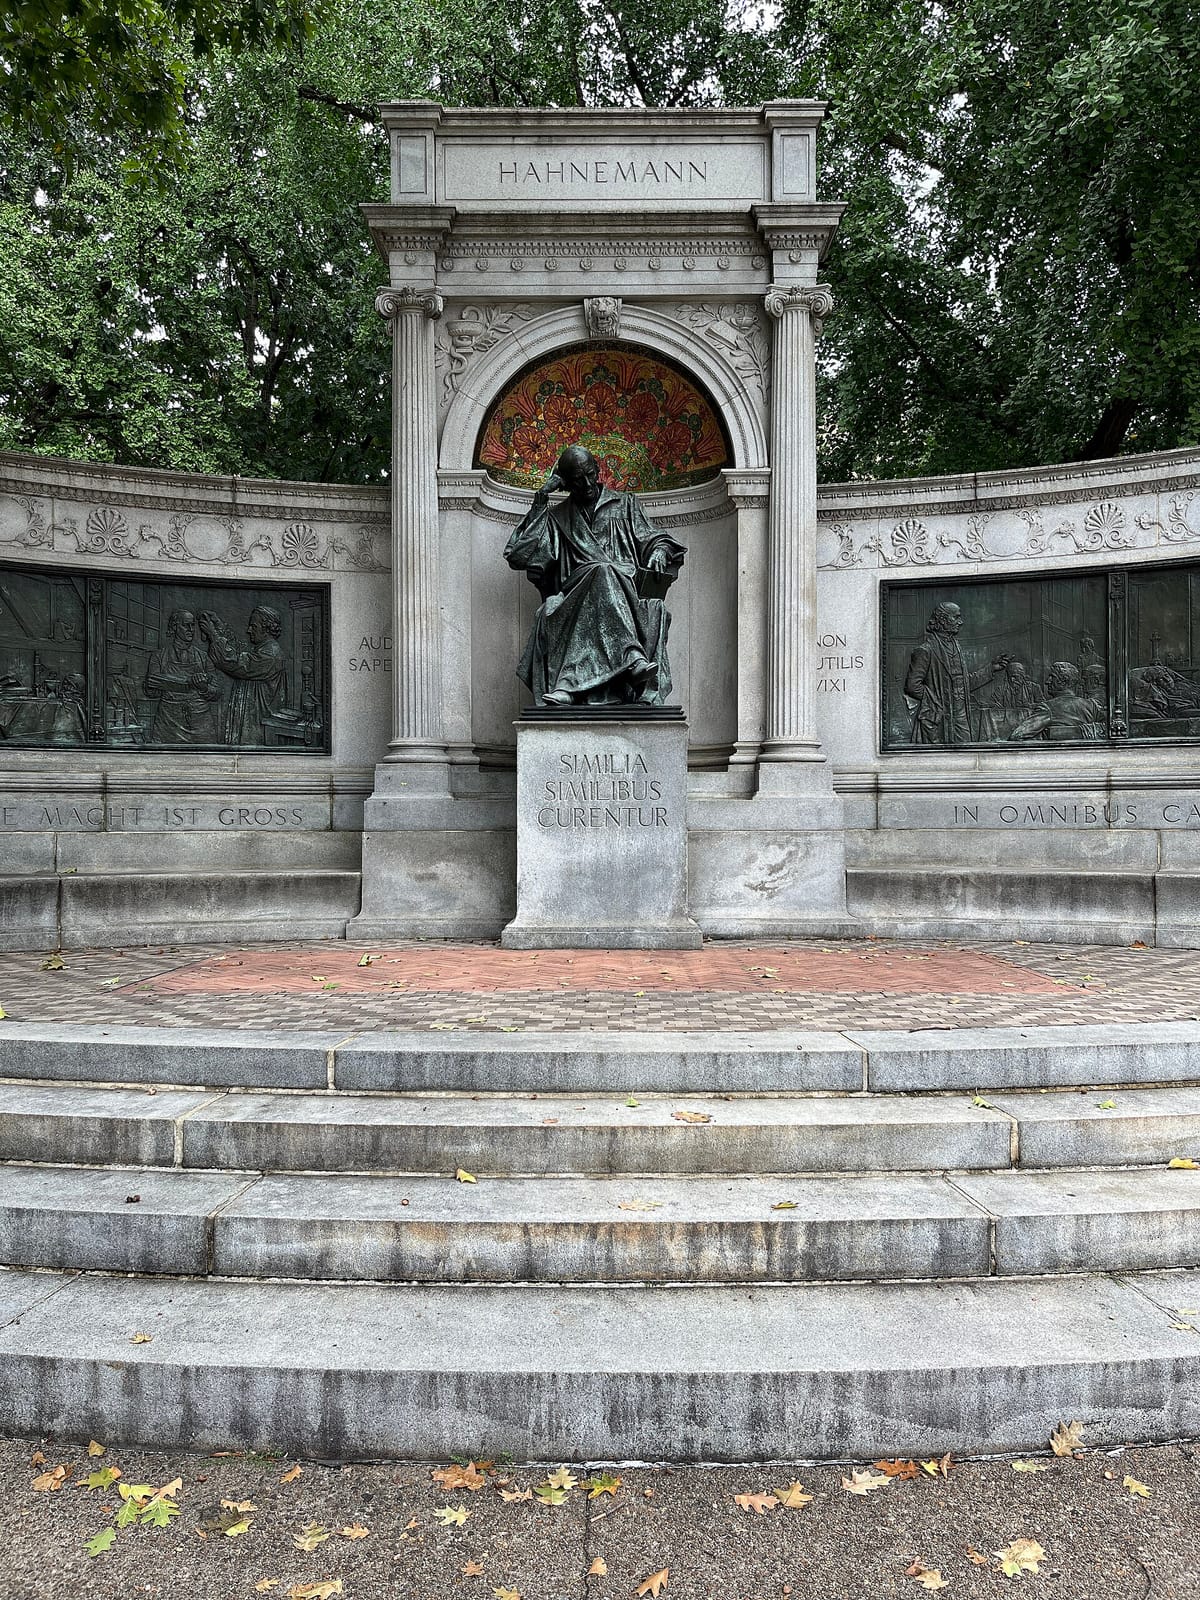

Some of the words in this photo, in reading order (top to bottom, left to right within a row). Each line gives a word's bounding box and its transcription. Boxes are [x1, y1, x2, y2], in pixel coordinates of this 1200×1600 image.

[499, 161, 707, 183] HAHNEMANN
[358, 636, 392, 650] AUD
[349, 658, 392, 671] SAPE
[559, 753, 648, 774] SIMILIA
[544, 780, 661, 801] SIMILIBUS
[2, 807, 18, 826] E
[40, 807, 144, 826] MACHT
[164, 807, 202, 826] IST
[218, 808, 303, 826] GROSS
[537, 807, 669, 828] CURENTUR
[954, 805, 979, 824] IN
[999, 804, 1138, 824] OMNIBUS
[1162, 803, 1200, 824] CA
